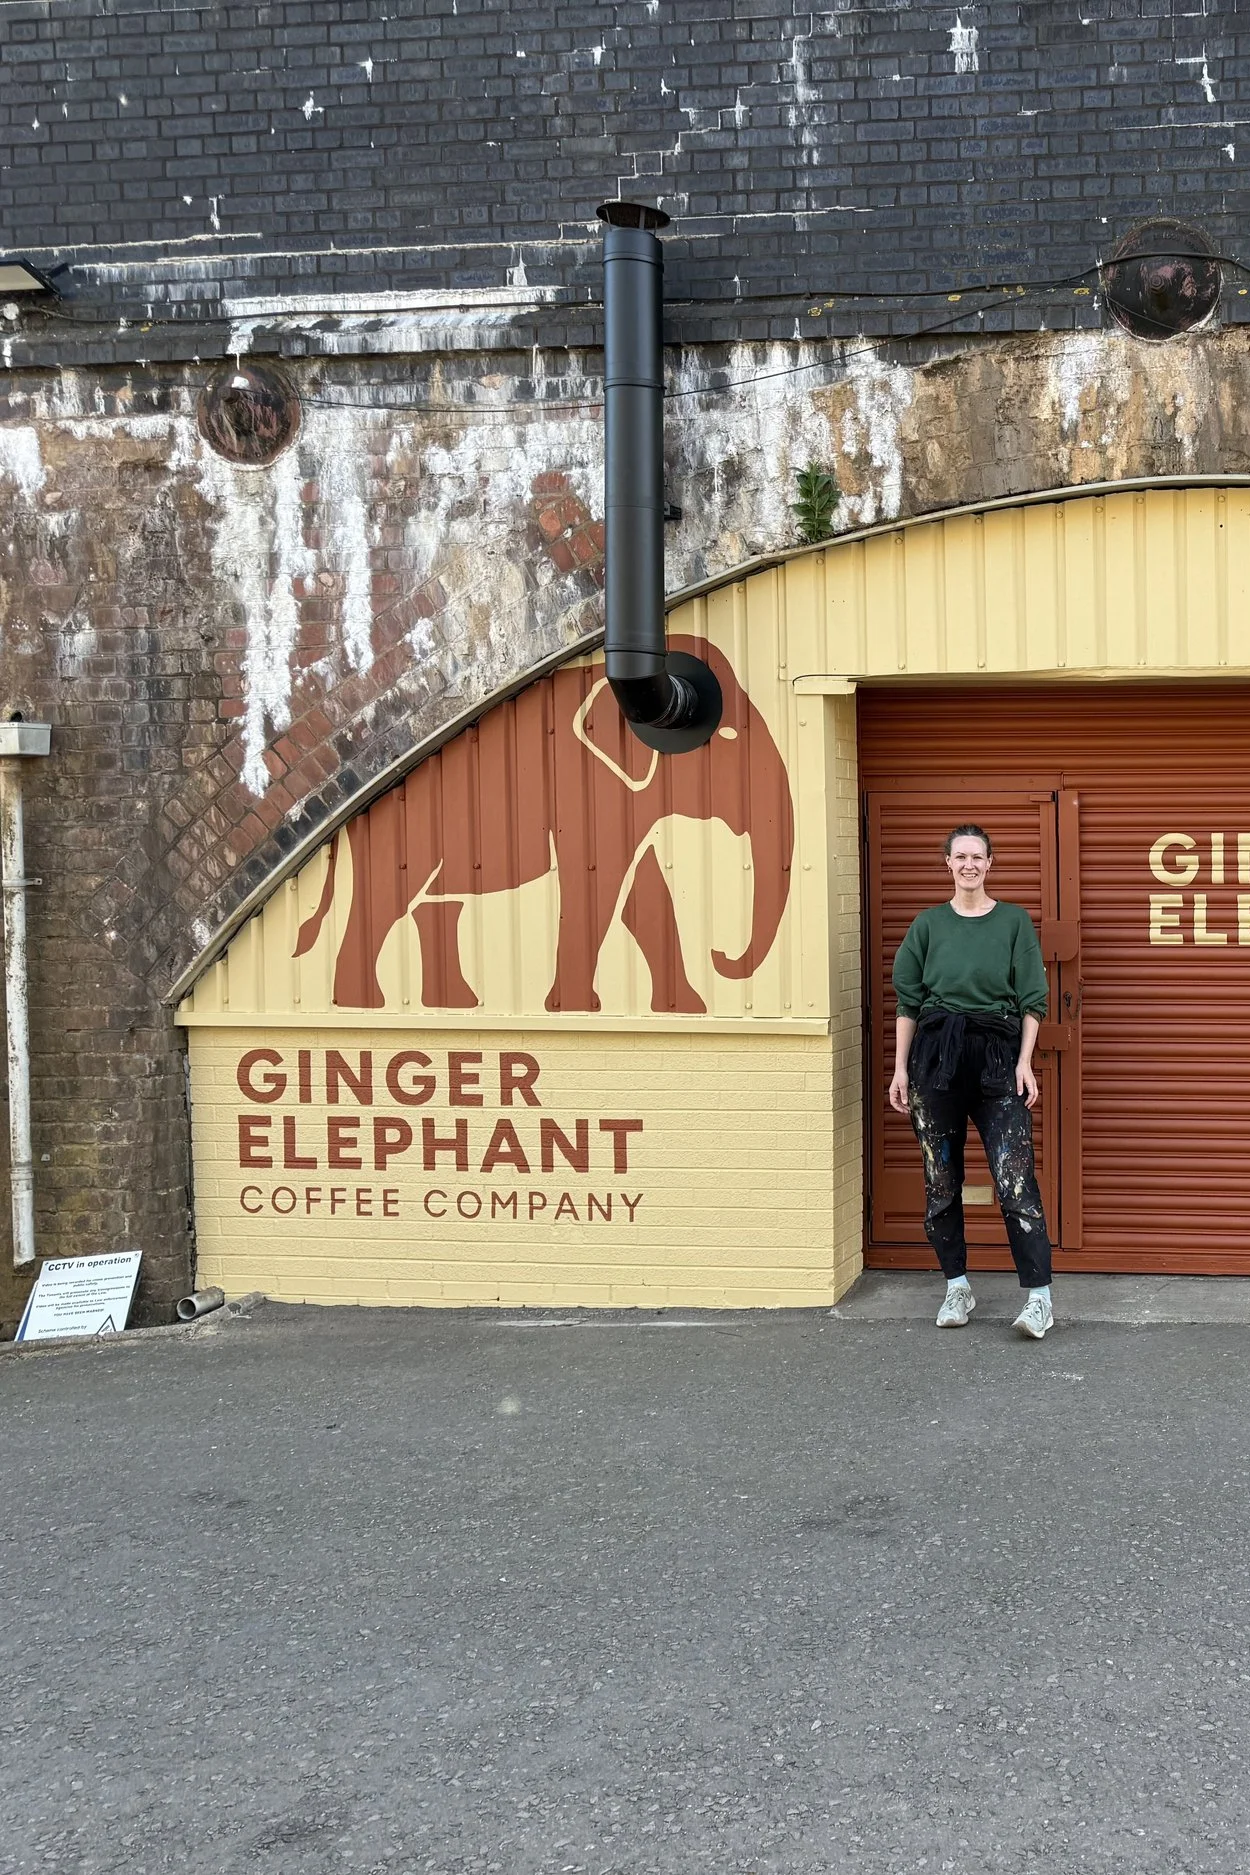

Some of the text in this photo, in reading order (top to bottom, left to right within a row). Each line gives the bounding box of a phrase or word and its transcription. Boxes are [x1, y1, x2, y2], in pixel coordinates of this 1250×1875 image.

[236, 1048, 542, 1106] GINGER
[238, 1115, 644, 1174] ELEPHANT
[240, 1185, 644, 1222] COFFEE COMPANY
[48, 1261, 75, 1272] CCTV
[87, 1257, 132, 1269] operation
